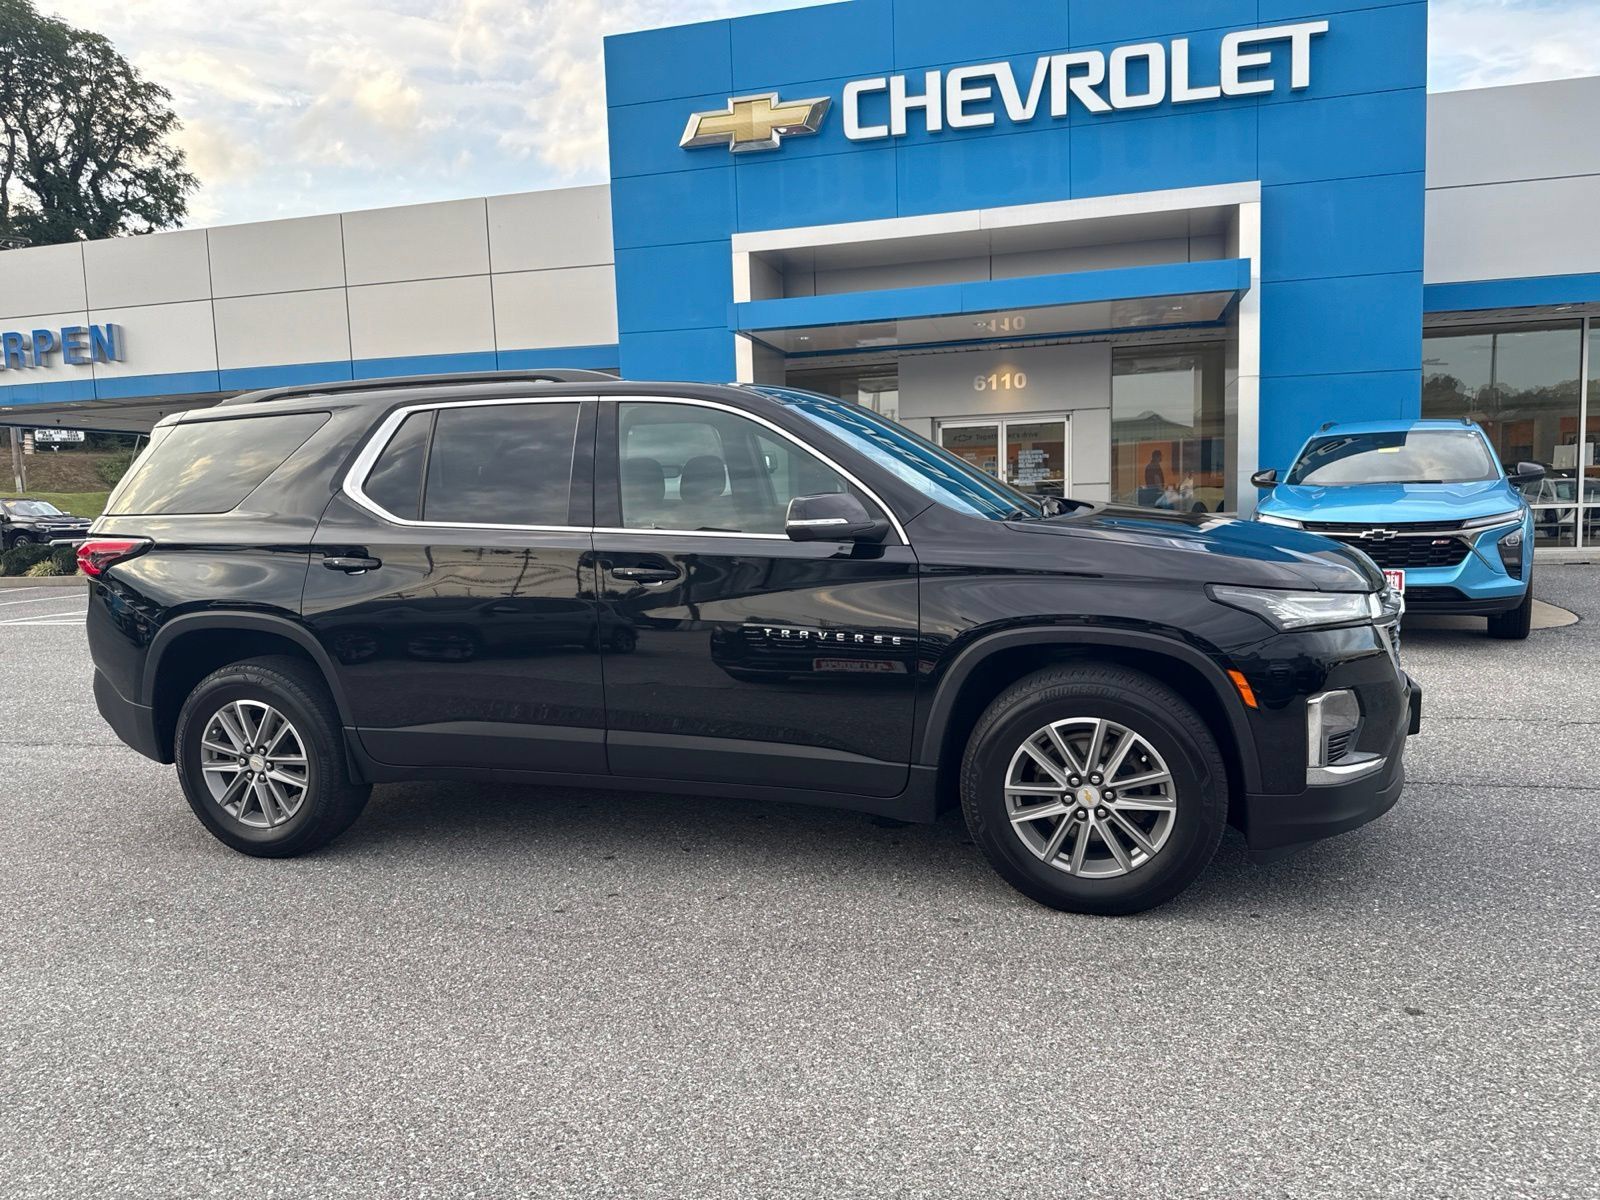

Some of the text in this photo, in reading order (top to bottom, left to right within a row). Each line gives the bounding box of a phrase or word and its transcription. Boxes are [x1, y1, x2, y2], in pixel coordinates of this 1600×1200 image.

[842, 20, 1330, 142] CHEVROLET
[0, 323, 124, 370] RPEN
[973, 372, 1027, 391] 6110
[763, 628, 901, 645] TRAVERSE
